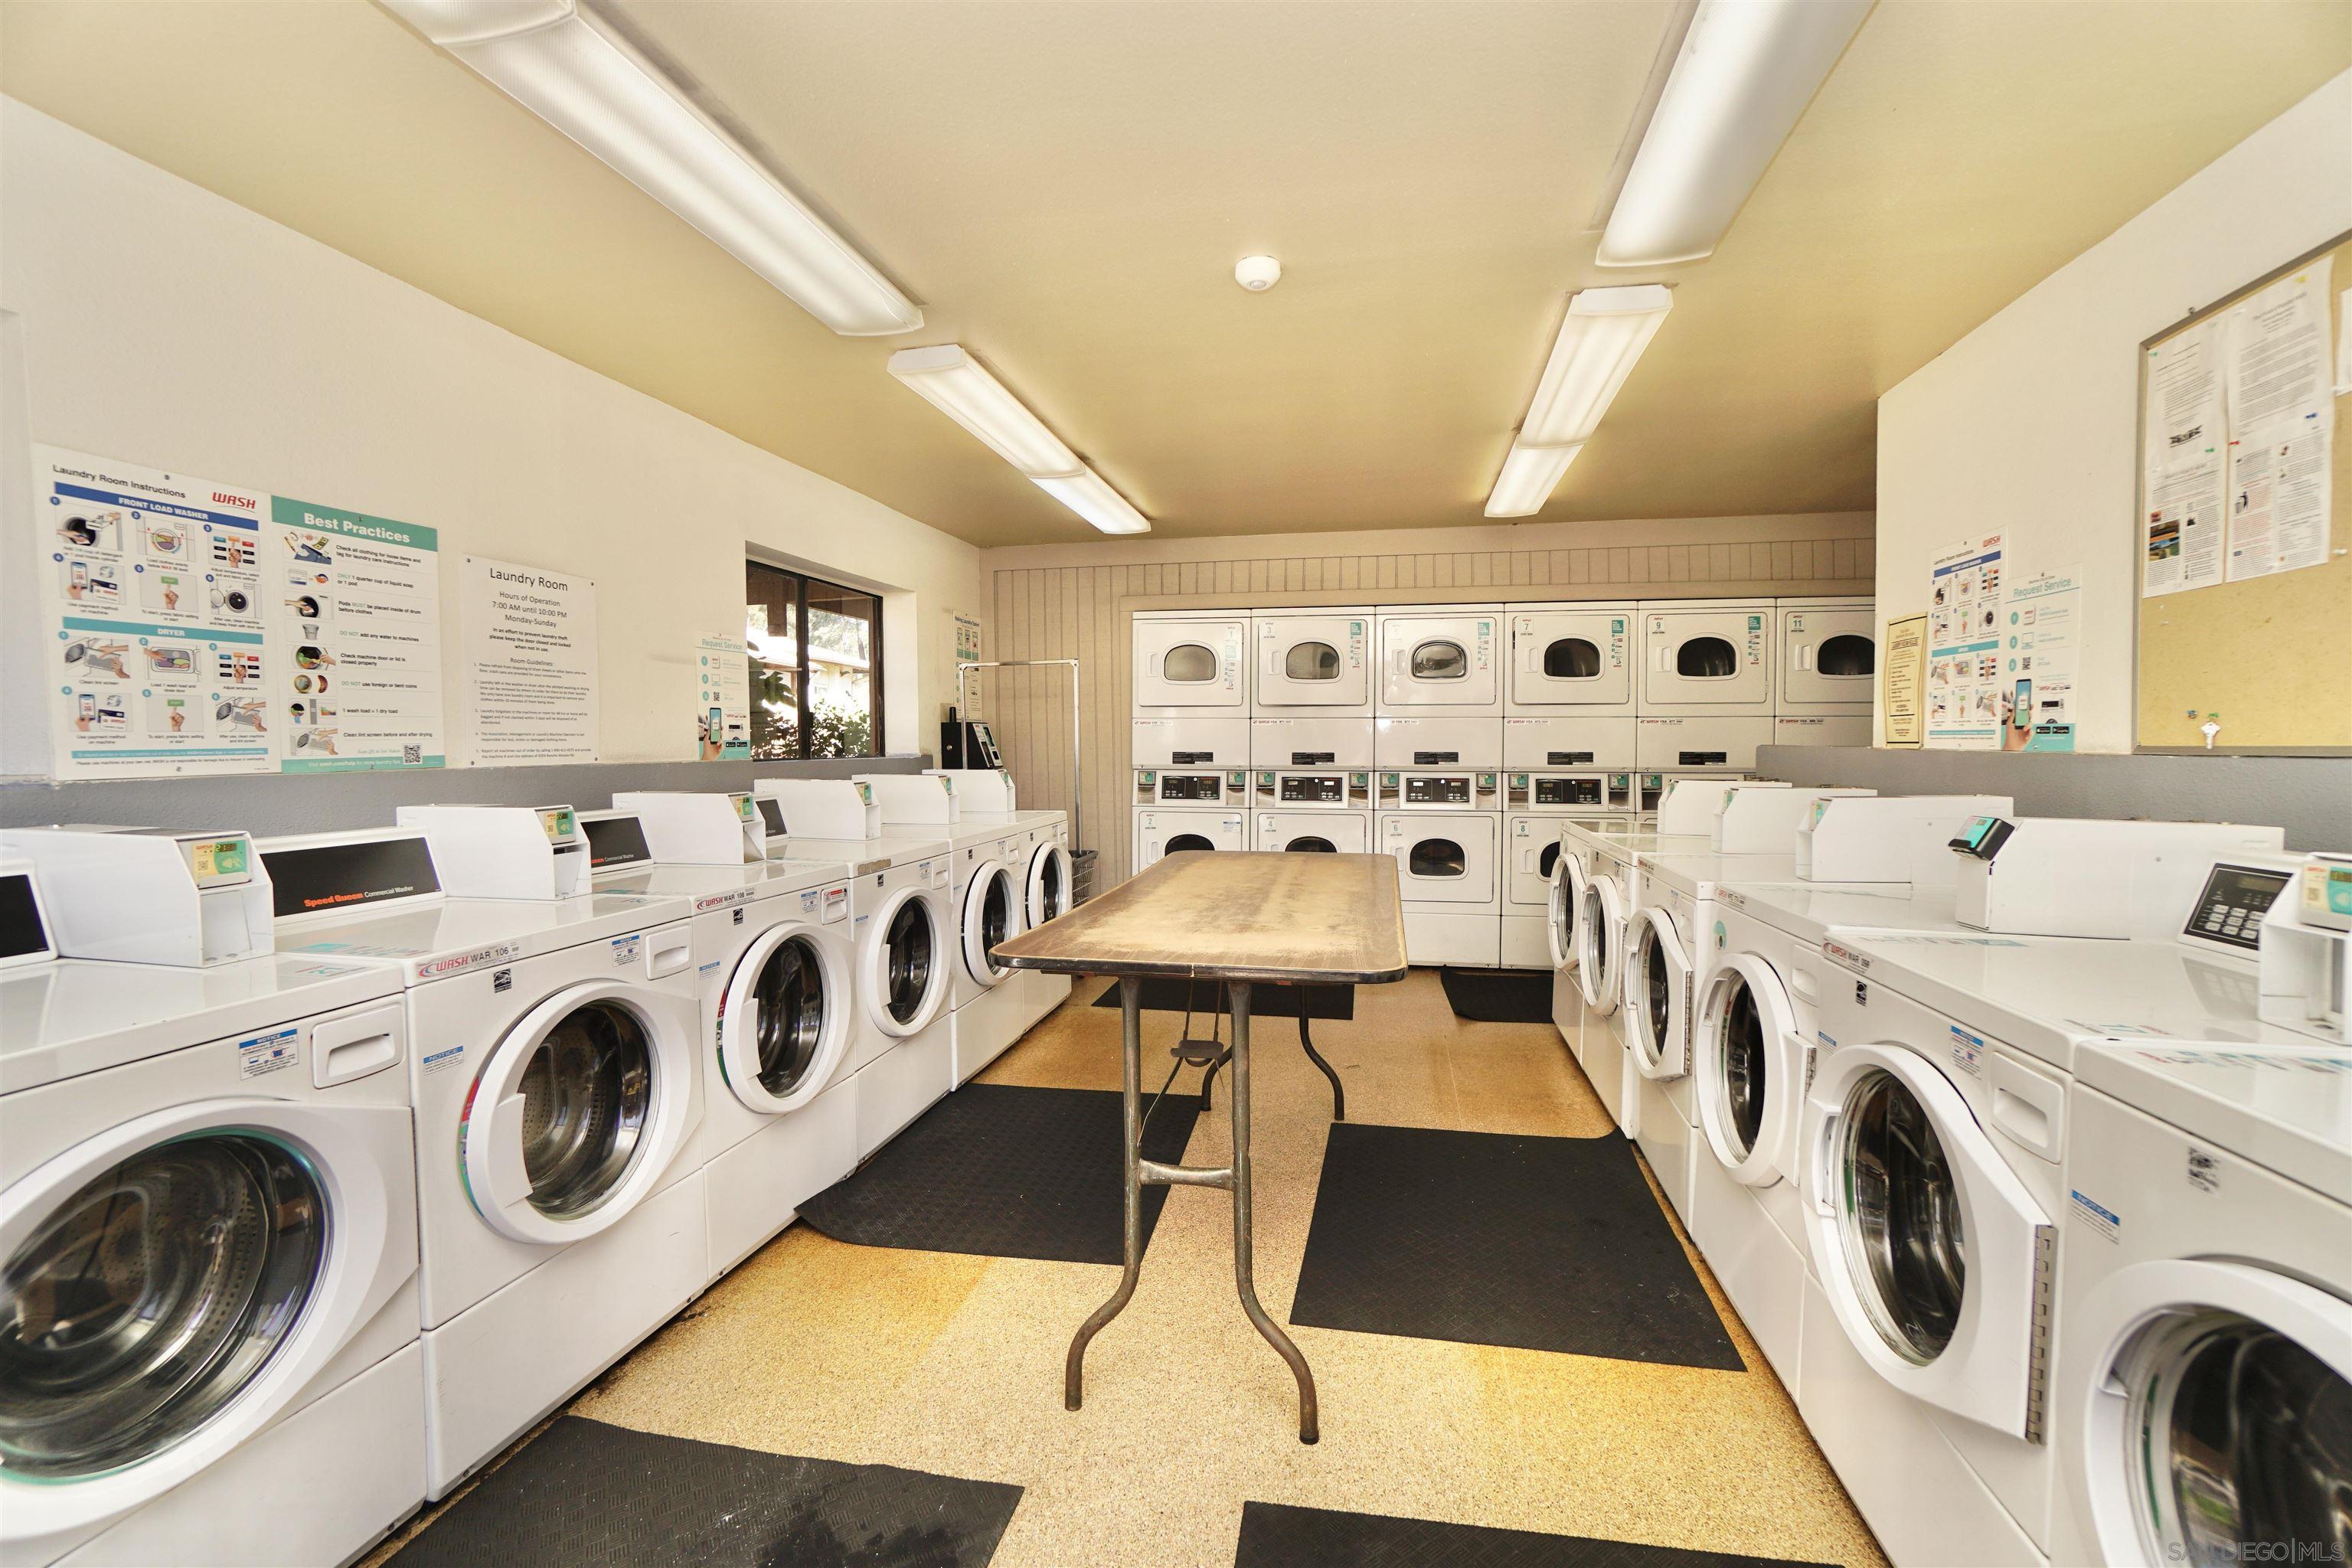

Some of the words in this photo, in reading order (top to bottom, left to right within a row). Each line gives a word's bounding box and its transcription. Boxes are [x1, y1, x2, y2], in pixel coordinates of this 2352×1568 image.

[53, 464, 96, 482] Laundry
[100, 474, 128, 487] Room
[131, 481, 185, 498] Instructions
[212, 492, 256, 509] WASH
[119, 498, 148, 510] FRONT
[150, 503, 173, 514] LOAD
[175, 507, 208, 521] WASHER
[304, 513, 339, 530] Best
[343, 521, 410, 542] Practices
[490, 568, 535, 587] Laundry
[538, 577, 568, 591] Room
[2014, 584, 2043, 597] Request
[2044, 579, 2071, 591] Service
[492, 601, 508, 609] 7:00
[499, 591, 519, 600] Hours
[529, 596, 560, 606] Operation
[505, 615, 557, 628] Monday-Sunday
[702, 639, 723, 649] Request
[724, 642, 743, 650] Service
[304, 896, 335, 907] Speed
[335, 893, 364, 903] Queen
[364, 888, 394, 898] Commercial
[705, 897, 723, 906] WASH
[436, 956, 469, 972] WASH
[470, 951, 490, 962] WAR
[495, 947, 509, 956] 106
[257, 1034, 281, 1043] NOTICE
[429, 1049, 457, 1061] NOTICE
[2077, 1194, 2114, 1220] NOTICE
